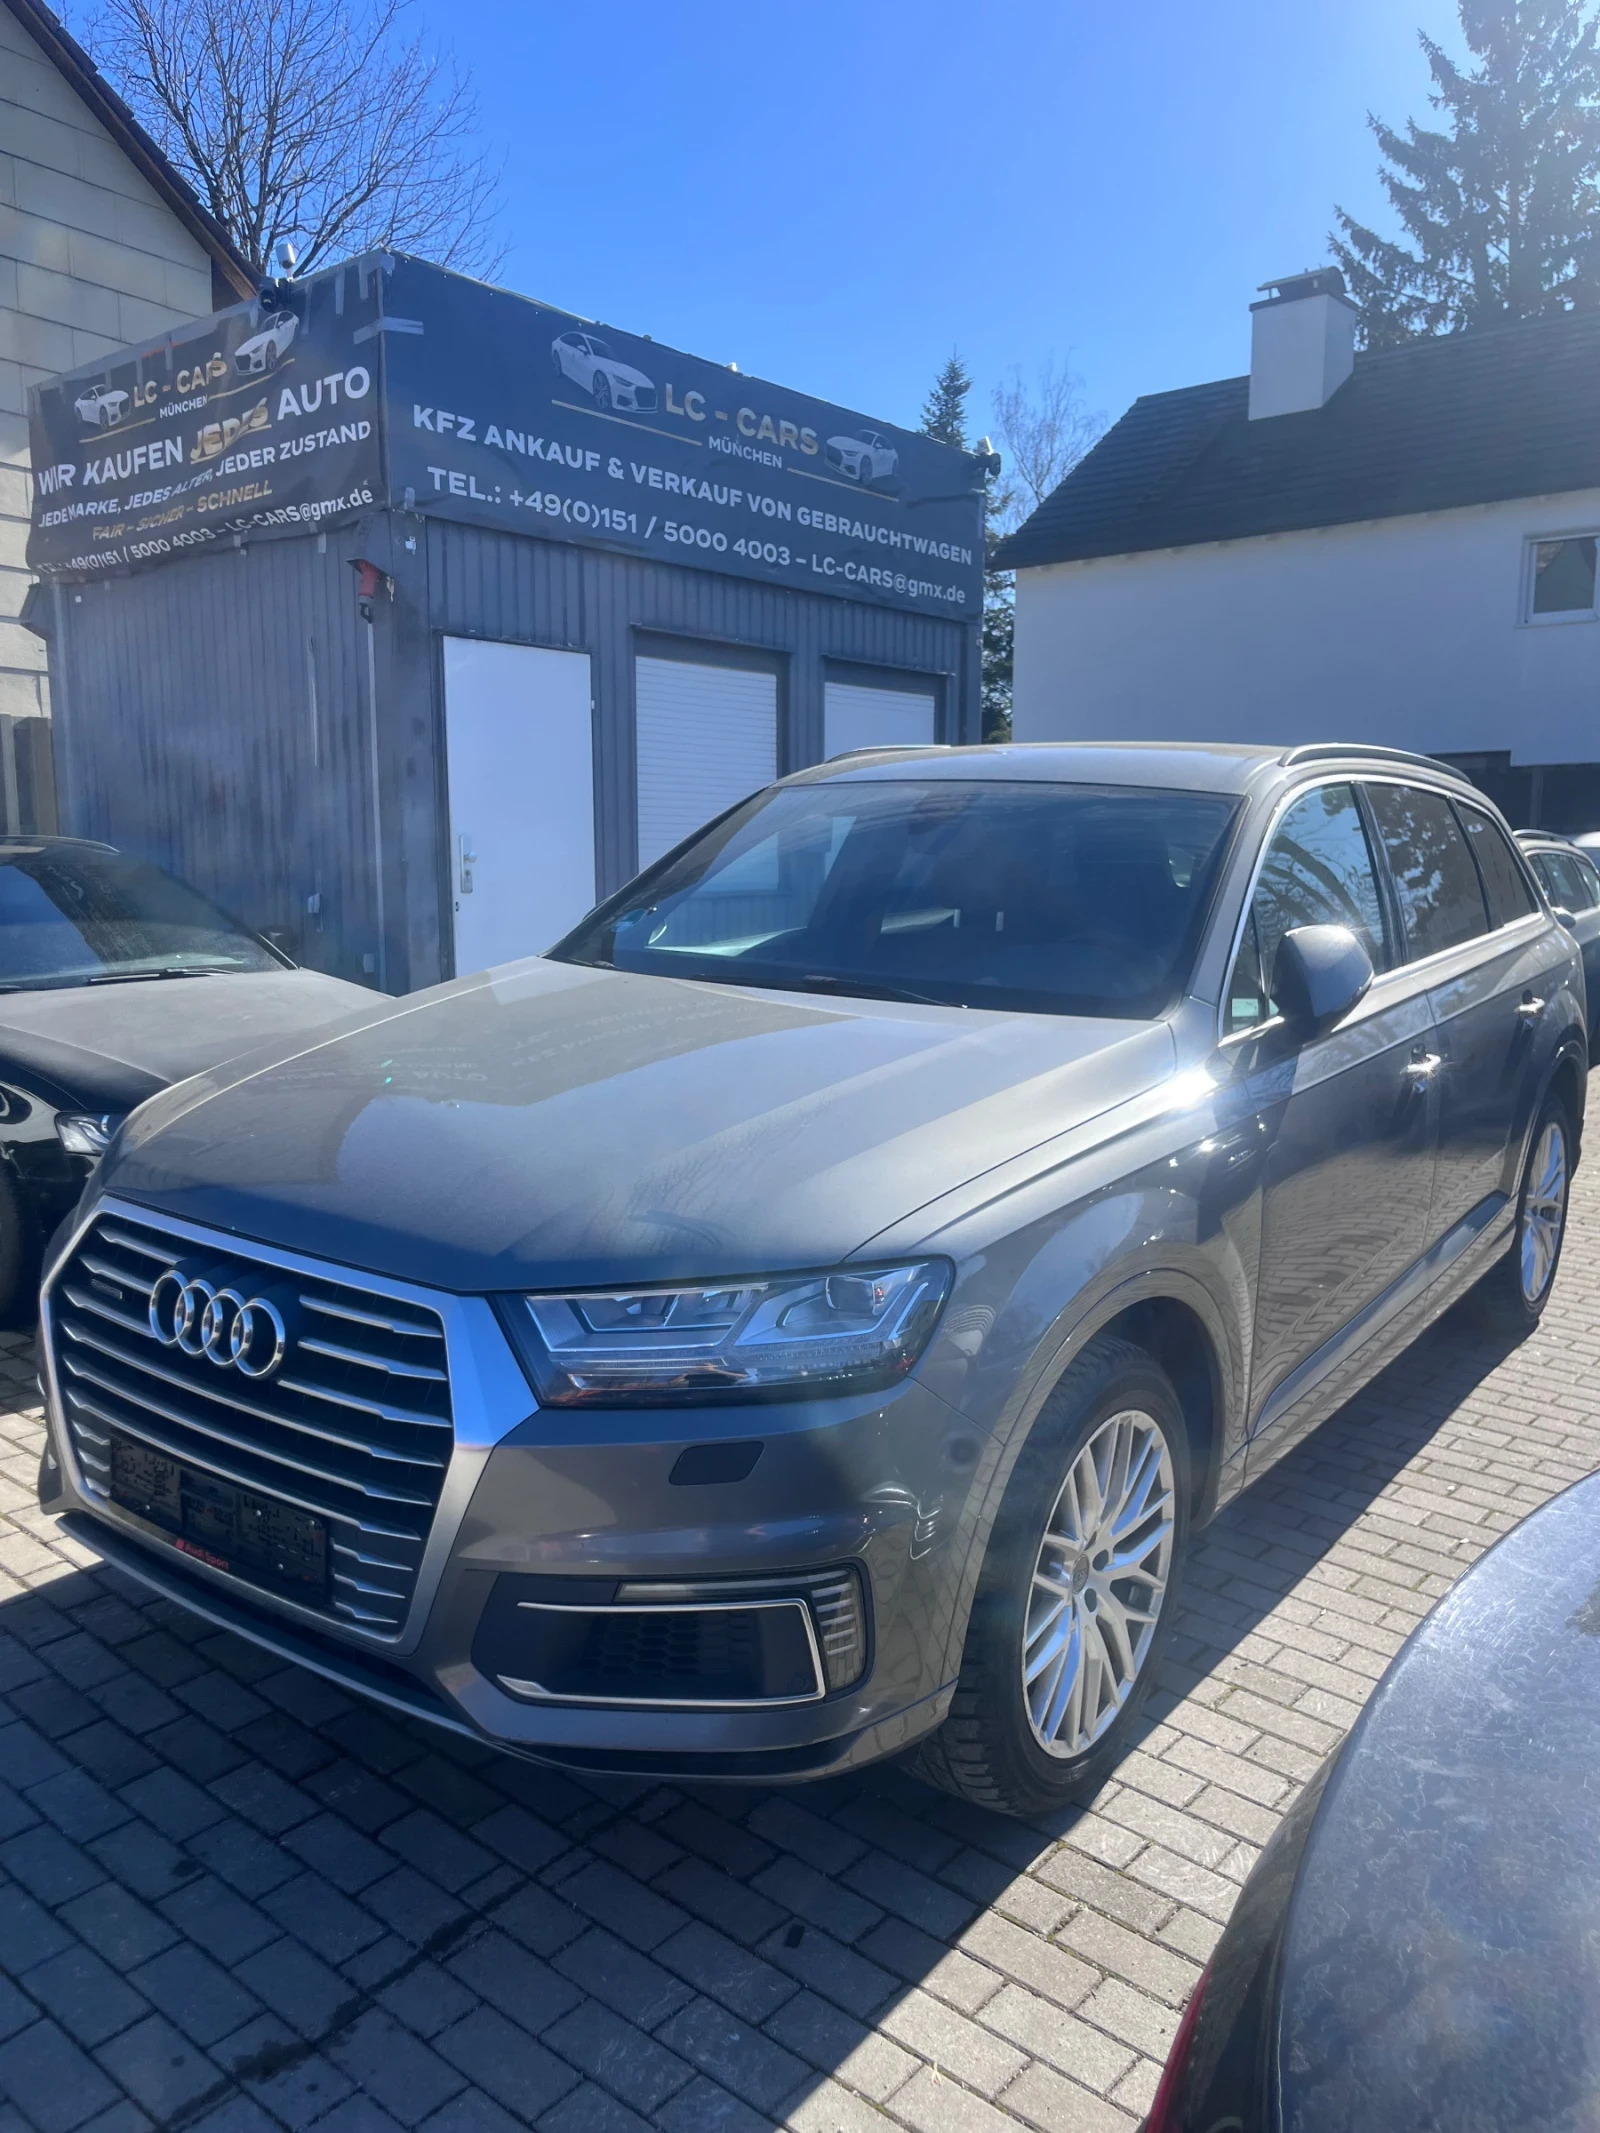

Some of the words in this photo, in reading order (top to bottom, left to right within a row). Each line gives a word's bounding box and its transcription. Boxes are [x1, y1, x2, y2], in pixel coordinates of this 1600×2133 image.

[134, 380, 158, 408] LC
[159, 395, 208, 418] MÜNCHEN
[665, 383, 706, 421] LC
[737, 407, 819, 456] CARS
[38, 463, 76, 495] WIR
[83, 436, 184, 485] KAUFEN
[277, 366, 371, 420] AUTO
[124, 486, 173, 510] JEDES
[171, 468, 213, 497] ALTER,
[215, 446, 276, 477] JEDER
[280, 420, 372, 460] ZUSTAND
[708, 435, 783, 469] MÜNCHEN
[93, 522, 125, 541] FAIR
[136, 505, 185, 532] SICHER
[197, 480, 273, 513] SCHNELL
[413, 404, 476, 442] KFZ
[484, 424, 601, 472] ANKAUF
[607, 457, 625, 480] &
[630, 462, 743, 507] VERKAUF
[747, 492, 792, 521] VON
[796, 506, 972, 565] GEBRAUCHTWAGEN
[130, 539, 172, 559] 5000
[172, 528, 216, 547] 4003
[225, 488, 374, 532] LC-CARS@gmx.de
[427, 466, 502, 504] TEL.:
[509, 489, 637, 534] +49(0)151
[644, 516, 658, 539] /
[663, 521, 728, 552] 5000
[732, 537, 791, 566] 4003
[812, 554, 966, 604] LC-CARS@gmx.de
